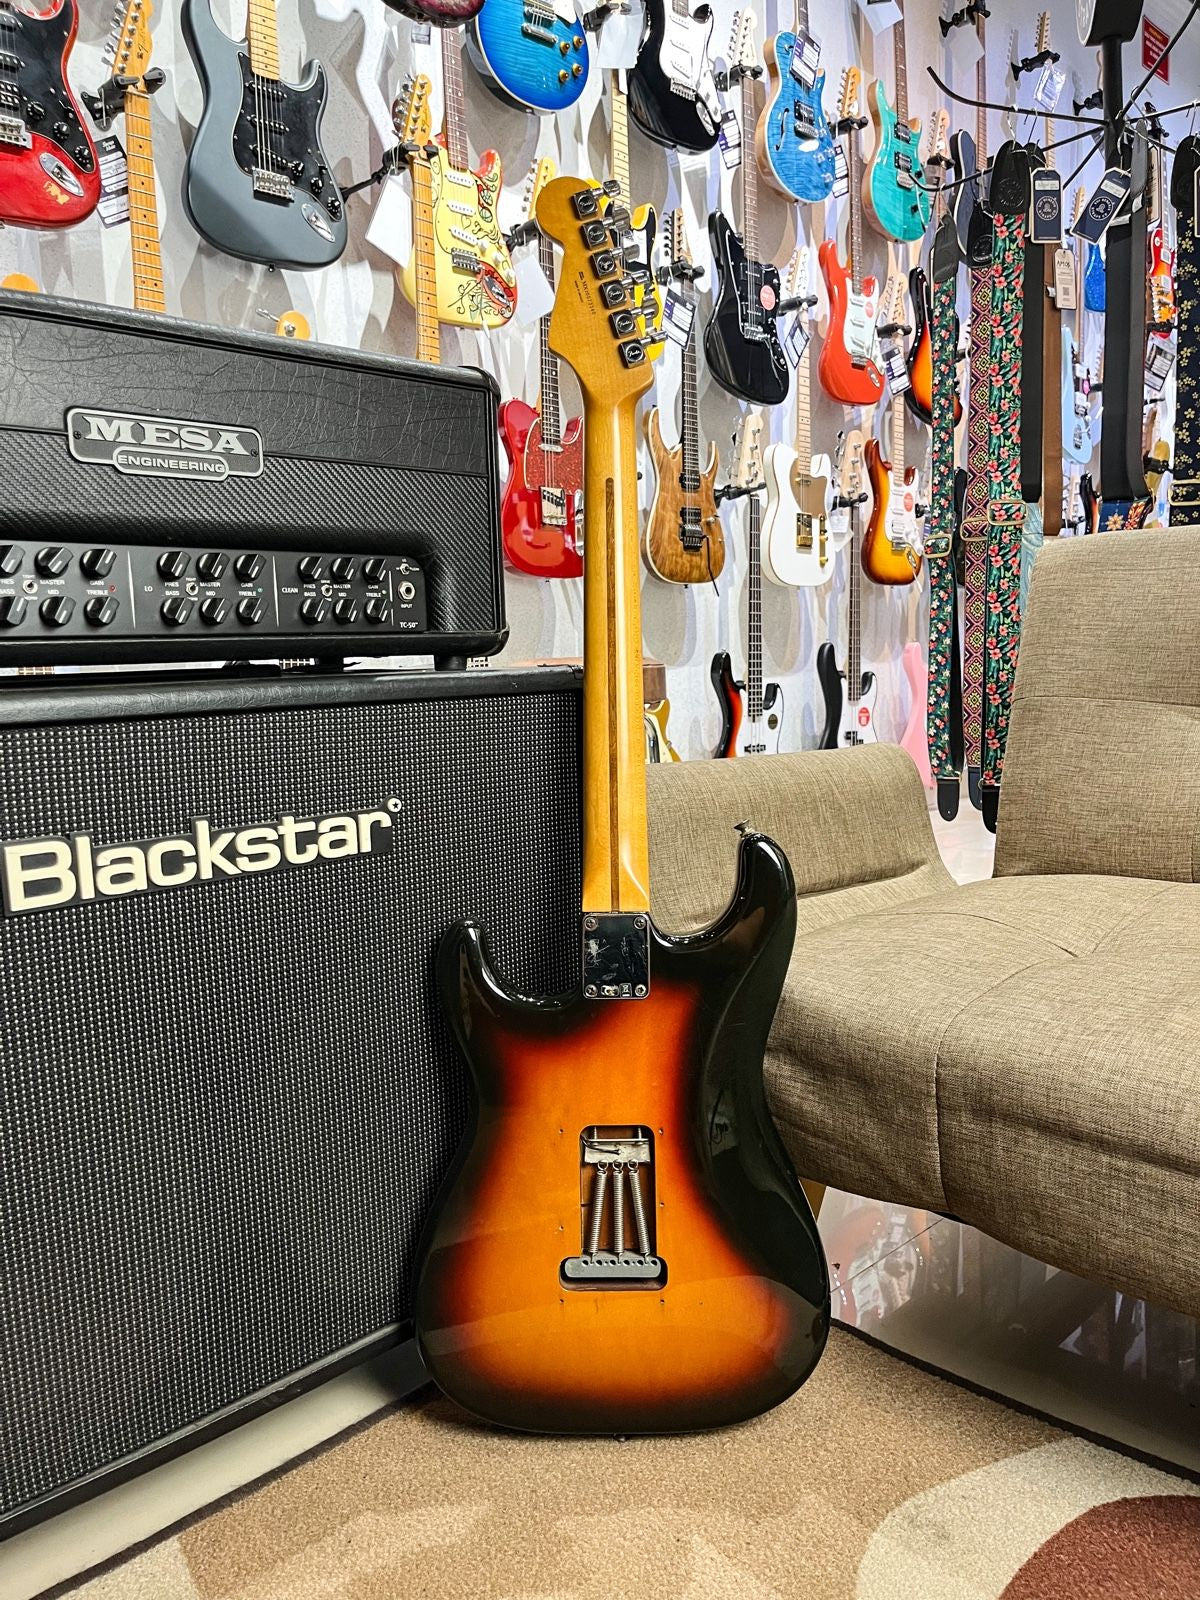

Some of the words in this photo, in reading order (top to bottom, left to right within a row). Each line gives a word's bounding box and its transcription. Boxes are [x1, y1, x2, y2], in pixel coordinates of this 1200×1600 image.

[82, 415, 250, 456] MESA
[117, 454, 225, 473] ENGINEERING
[4, 810, 393, 913] Blackstar
